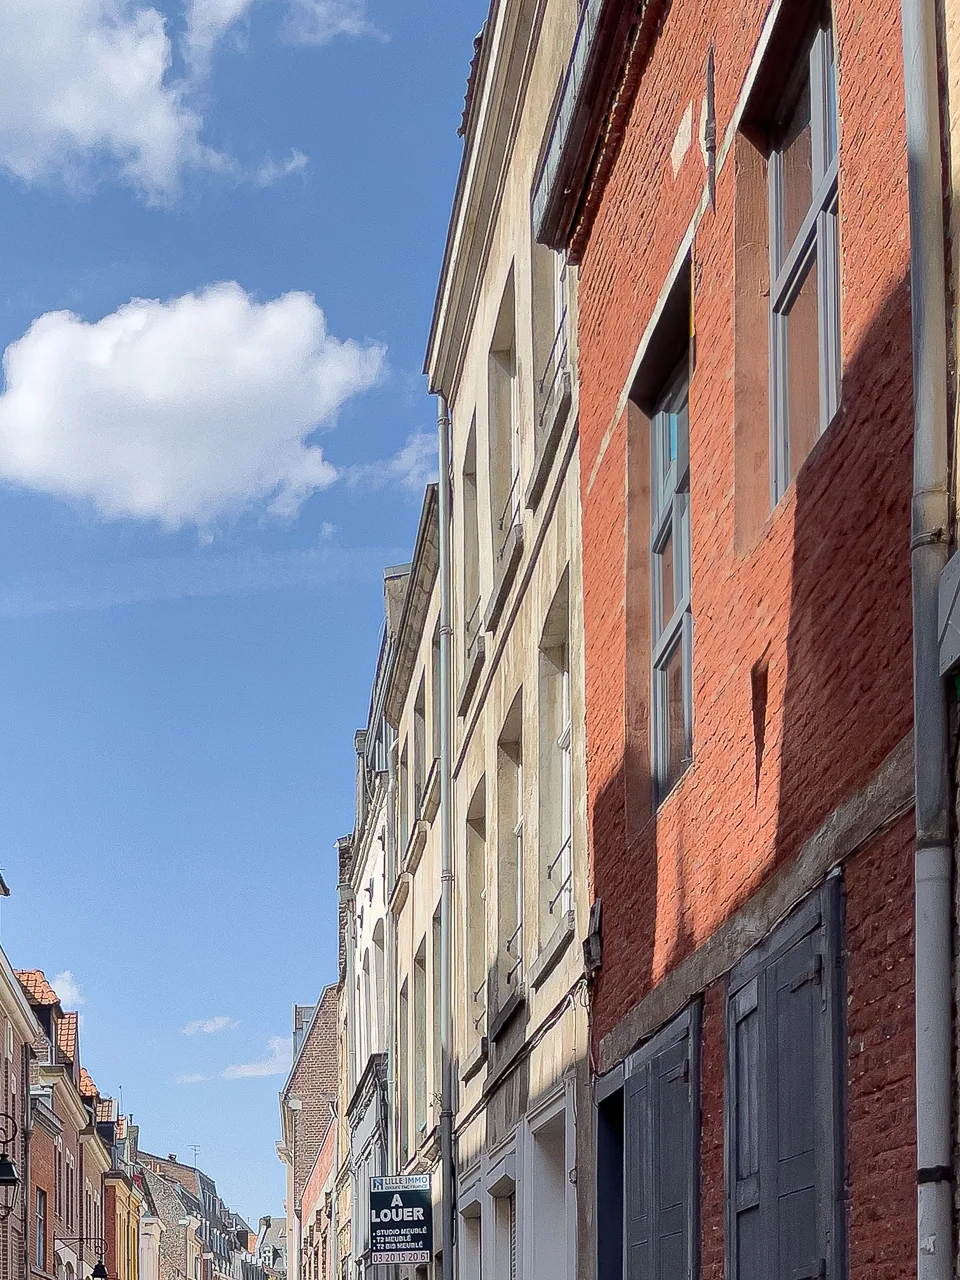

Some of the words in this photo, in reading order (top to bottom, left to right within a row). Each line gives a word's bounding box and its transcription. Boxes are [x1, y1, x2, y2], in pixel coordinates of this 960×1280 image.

[384, 1177, 403, 1185] LILLE
[405, 1176, 428, 1184] IMMO
[390, 1193, 404, 1207] A
[371, 1207, 425, 1223] LOUER
[400, 1226, 428, 1235] MEUBLÉ
[385, 1234, 412, 1243] MEUBLÉ
[397, 1240, 424, 1249] MEUBLÉ
[373, 1253, 383, 1263] 03
[385, 1253, 396, 1262] 20
[397, 1252, 406, 1262] 15
[408, 1252, 419, 1262] 20
[420, 1251, 429, 1261] 61
